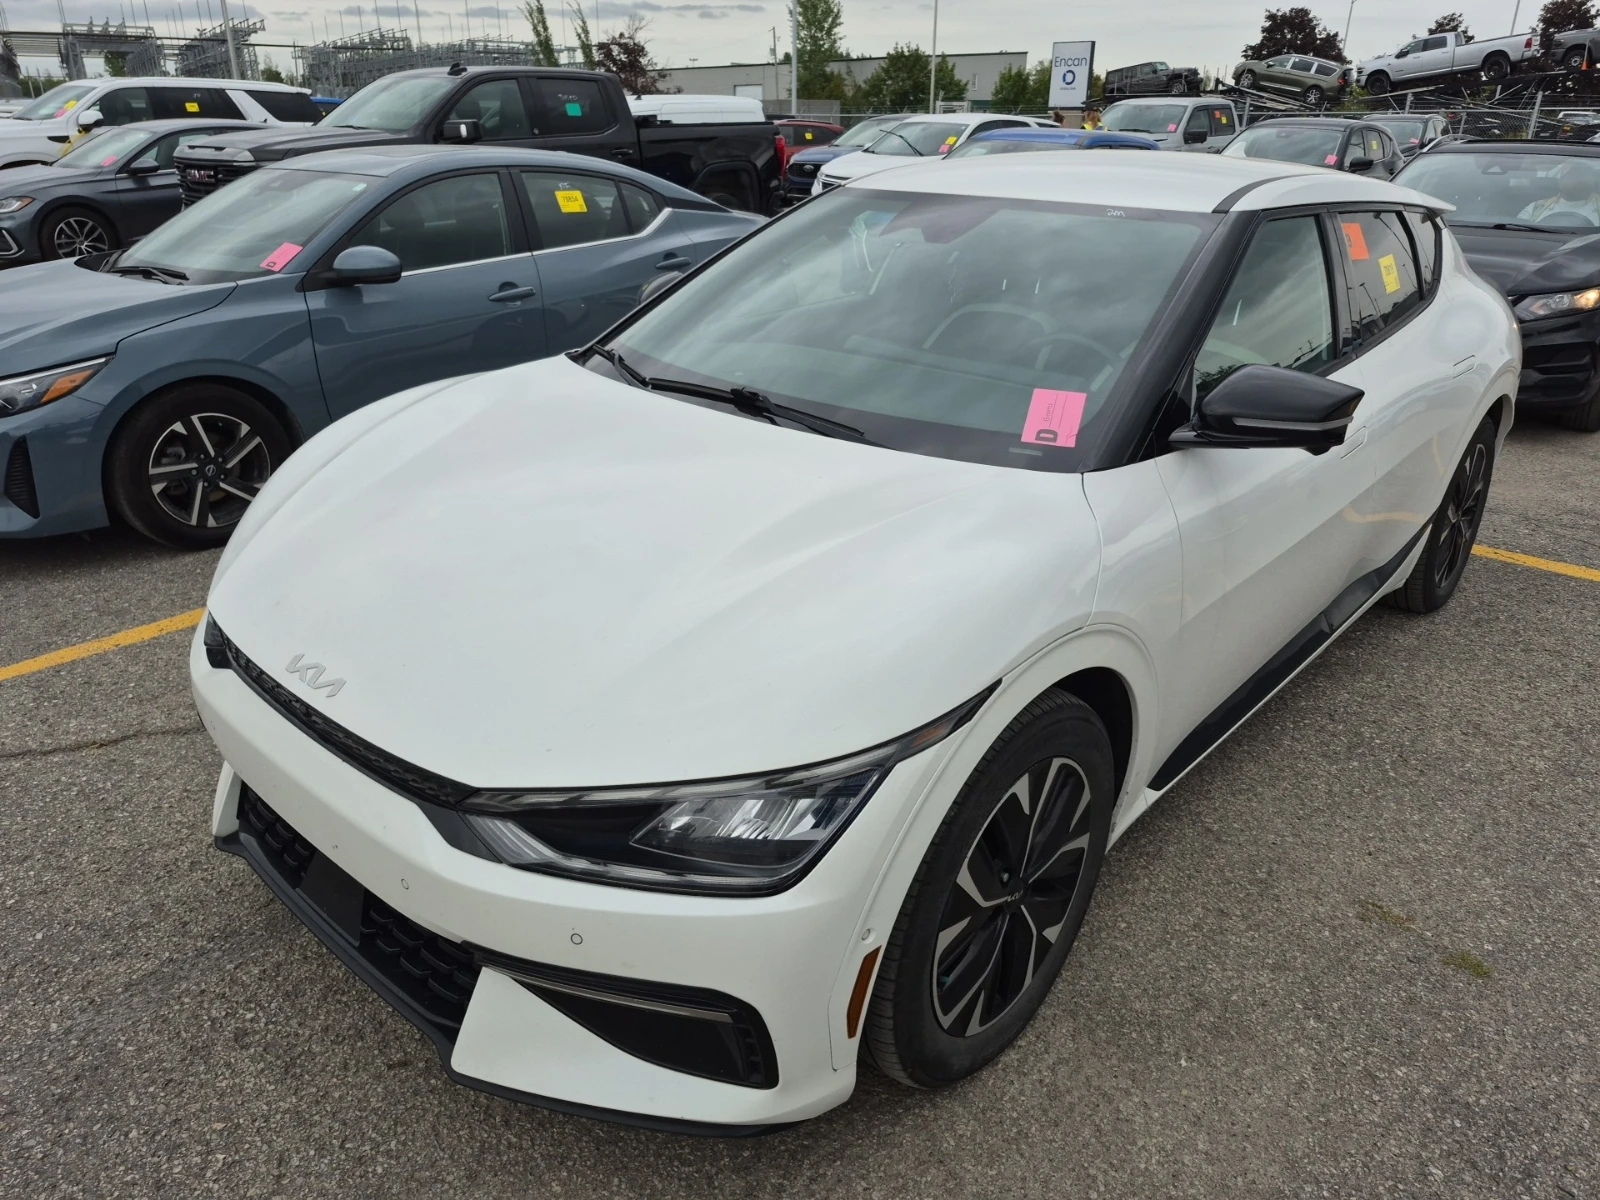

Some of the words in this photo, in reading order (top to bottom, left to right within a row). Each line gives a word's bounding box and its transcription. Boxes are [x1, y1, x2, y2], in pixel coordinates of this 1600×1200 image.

[1054, 56, 1088, 67] Encan
[186, 169, 215, 183] GMC
[1035, 428, 1058, 443] D
[285, 653, 347, 698] KIA
